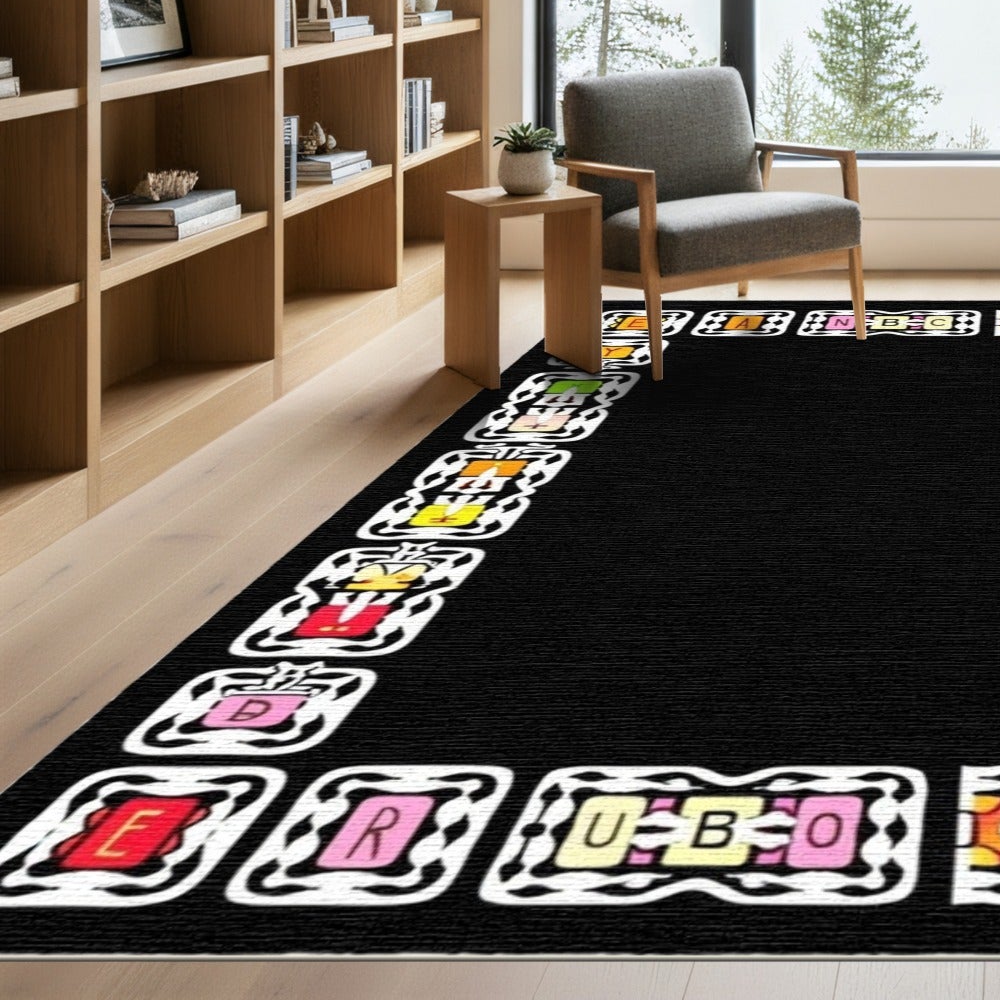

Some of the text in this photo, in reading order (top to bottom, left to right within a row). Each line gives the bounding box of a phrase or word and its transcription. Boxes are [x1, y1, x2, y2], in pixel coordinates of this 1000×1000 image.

[734, 318, 749, 329] A
[93, 809, 164, 858] E
[345, 807, 400, 860] R
